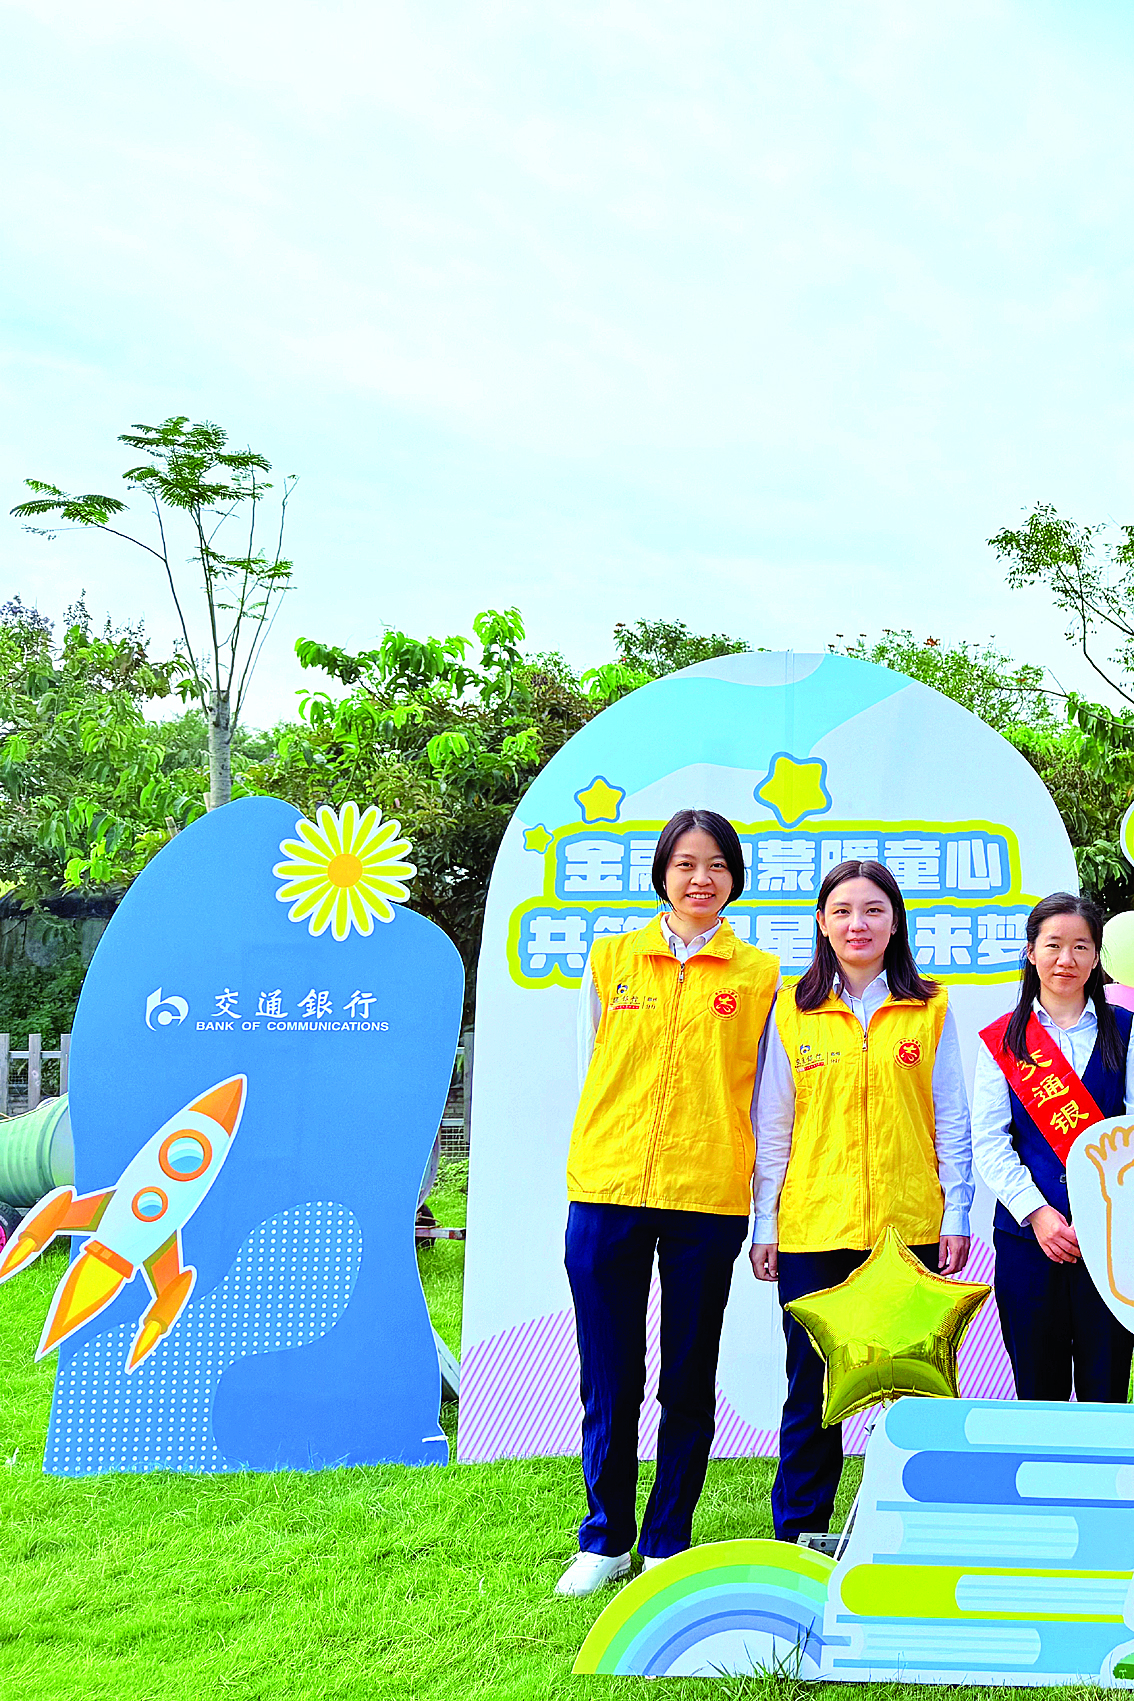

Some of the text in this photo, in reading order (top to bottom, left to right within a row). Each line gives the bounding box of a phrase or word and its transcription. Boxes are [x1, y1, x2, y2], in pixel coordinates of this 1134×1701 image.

[210, 987, 378, 1019] 交通銀行
[195, 1020, 390, 1032] BANK OF COMMUNICATIONS
